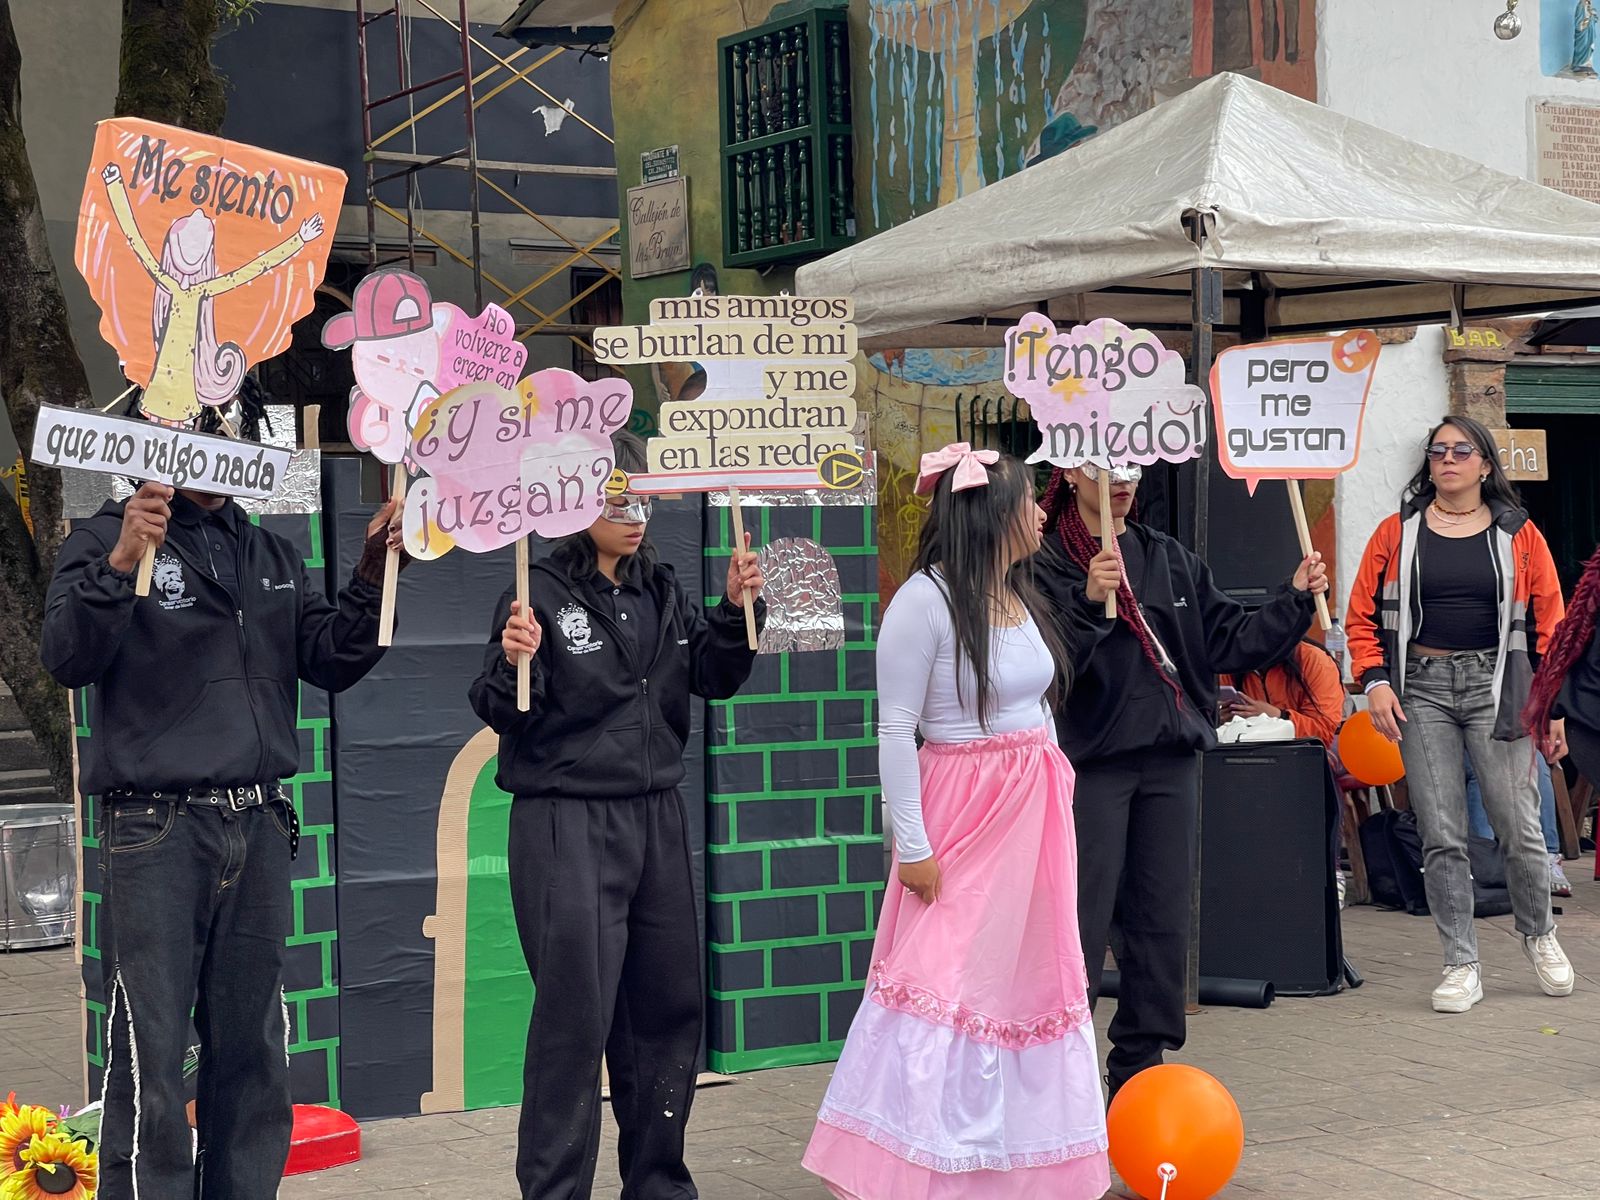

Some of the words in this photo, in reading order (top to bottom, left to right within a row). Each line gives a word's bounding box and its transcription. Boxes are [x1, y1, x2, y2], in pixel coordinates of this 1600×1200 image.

[129, 135, 186, 203] Me
[190, 157, 293, 224] siento
[630, 196, 669, 231] Callejón
[482, 307, 508, 336] No
[658, 298, 721, 320] mis
[727, 297, 848, 326] amigos
[455, 328, 512, 364] volvere
[513, 350, 524, 368] a
[594, 336, 630, 360] se
[637, 325, 744, 358] burlan
[752, 324, 795, 355] de
[801, 325, 849, 355] mi
[1451, 330, 1502, 348] BAR
[453, 356, 494, 382] creer
[495, 371, 516, 391] en
[764, 370, 788, 400] y
[793, 369, 848, 391] me
[1247, 359, 1329, 389] pero
[495, 391, 534, 443] si
[554, 391, 628, 435] me
[668, 398, 848, 440] expondran
[1260, 393, 1311, 417] me
[659, 448, 700, 471] en
[706, 437, 751, 470] las
[1046, 404, 1206, 471] miedo!
[46, 423, 96, 464] que
[100, 432, 135, 464] no
[143, 433, 208, 487] valgo
[214, 454, 275, 493] nada
[420, 456, 614, 554] juzgan?
